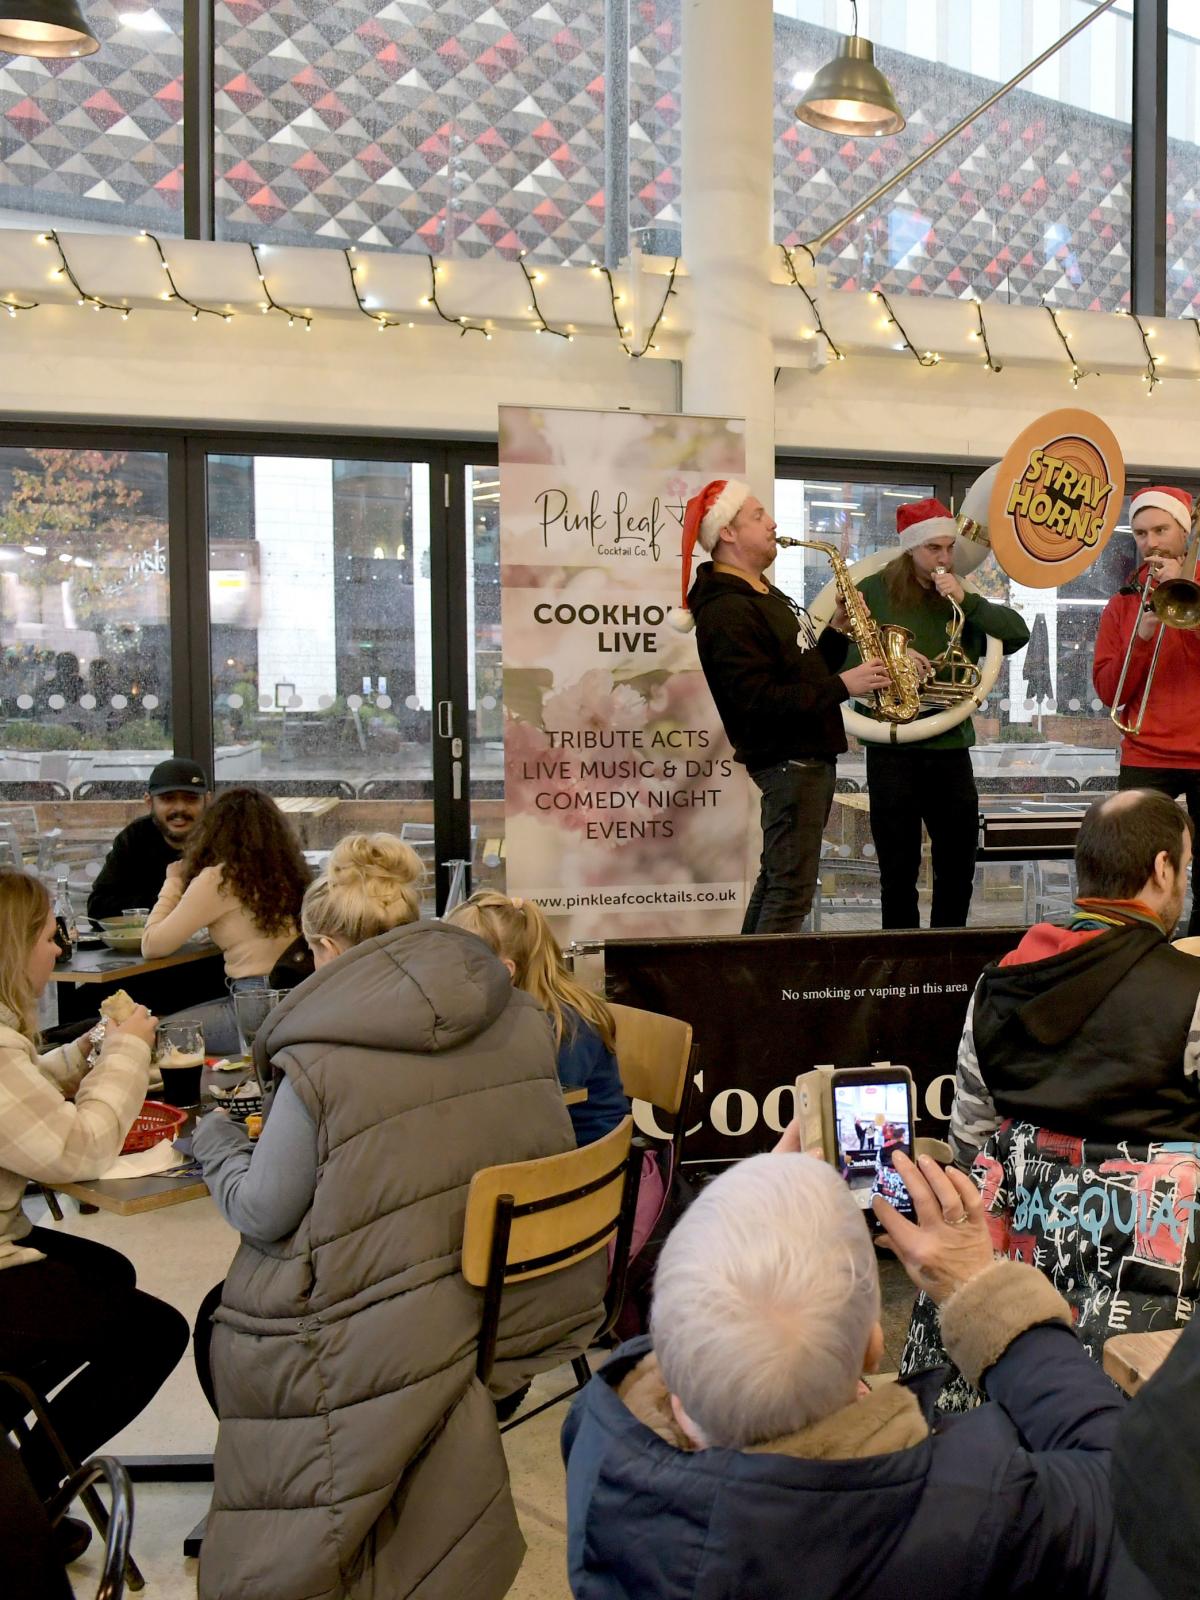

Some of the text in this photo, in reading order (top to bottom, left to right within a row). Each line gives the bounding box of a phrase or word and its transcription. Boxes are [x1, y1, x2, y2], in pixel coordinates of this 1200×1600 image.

[1025, 449, 1112, 509] STRAY
[1007, 482, 1105, 547] HORNS
[534, 489, 665, 562] Pink Leaf
[597, 545, 648, 557] Cocktail Co.
[534, 603, 682, 626] COOKHO
[598, 632, 657, 653] LIVE
[545, 730, 710, 748] TRIBUTE ACTS
[523, 760, 732, 780] LIVE MUSIC & DJ'S
[536, 789, 722, 810] COMEDY NIGHT
[587, 820, 674, 840] EVENTS
[532, 889, 736, 909] ww.pinkleafcocktails.co.uk
[781, 982, 968, 1001] No smoking or vaping in this area
